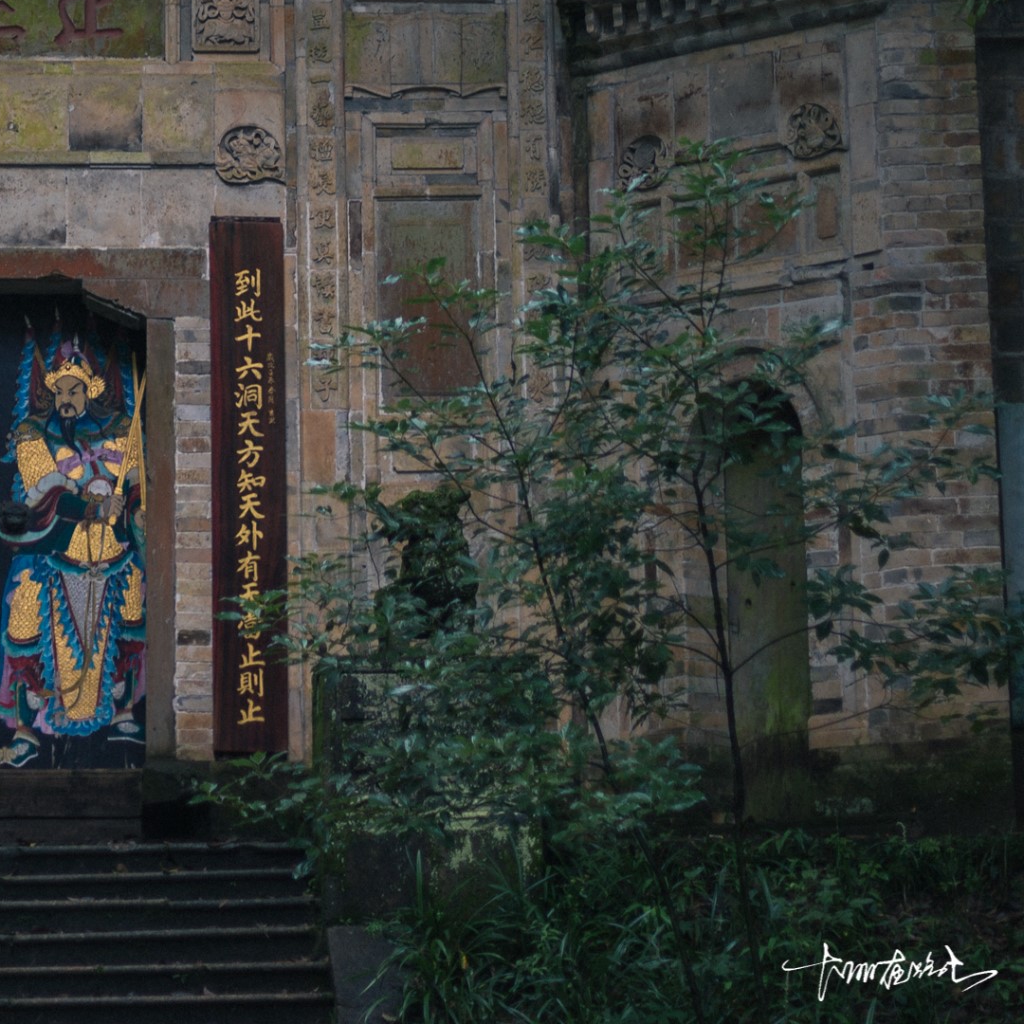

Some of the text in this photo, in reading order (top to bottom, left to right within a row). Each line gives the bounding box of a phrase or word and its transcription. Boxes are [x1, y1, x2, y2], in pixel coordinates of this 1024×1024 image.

[234, 267, 266, 725] 到此十六洞天方知天外有天當止則止
